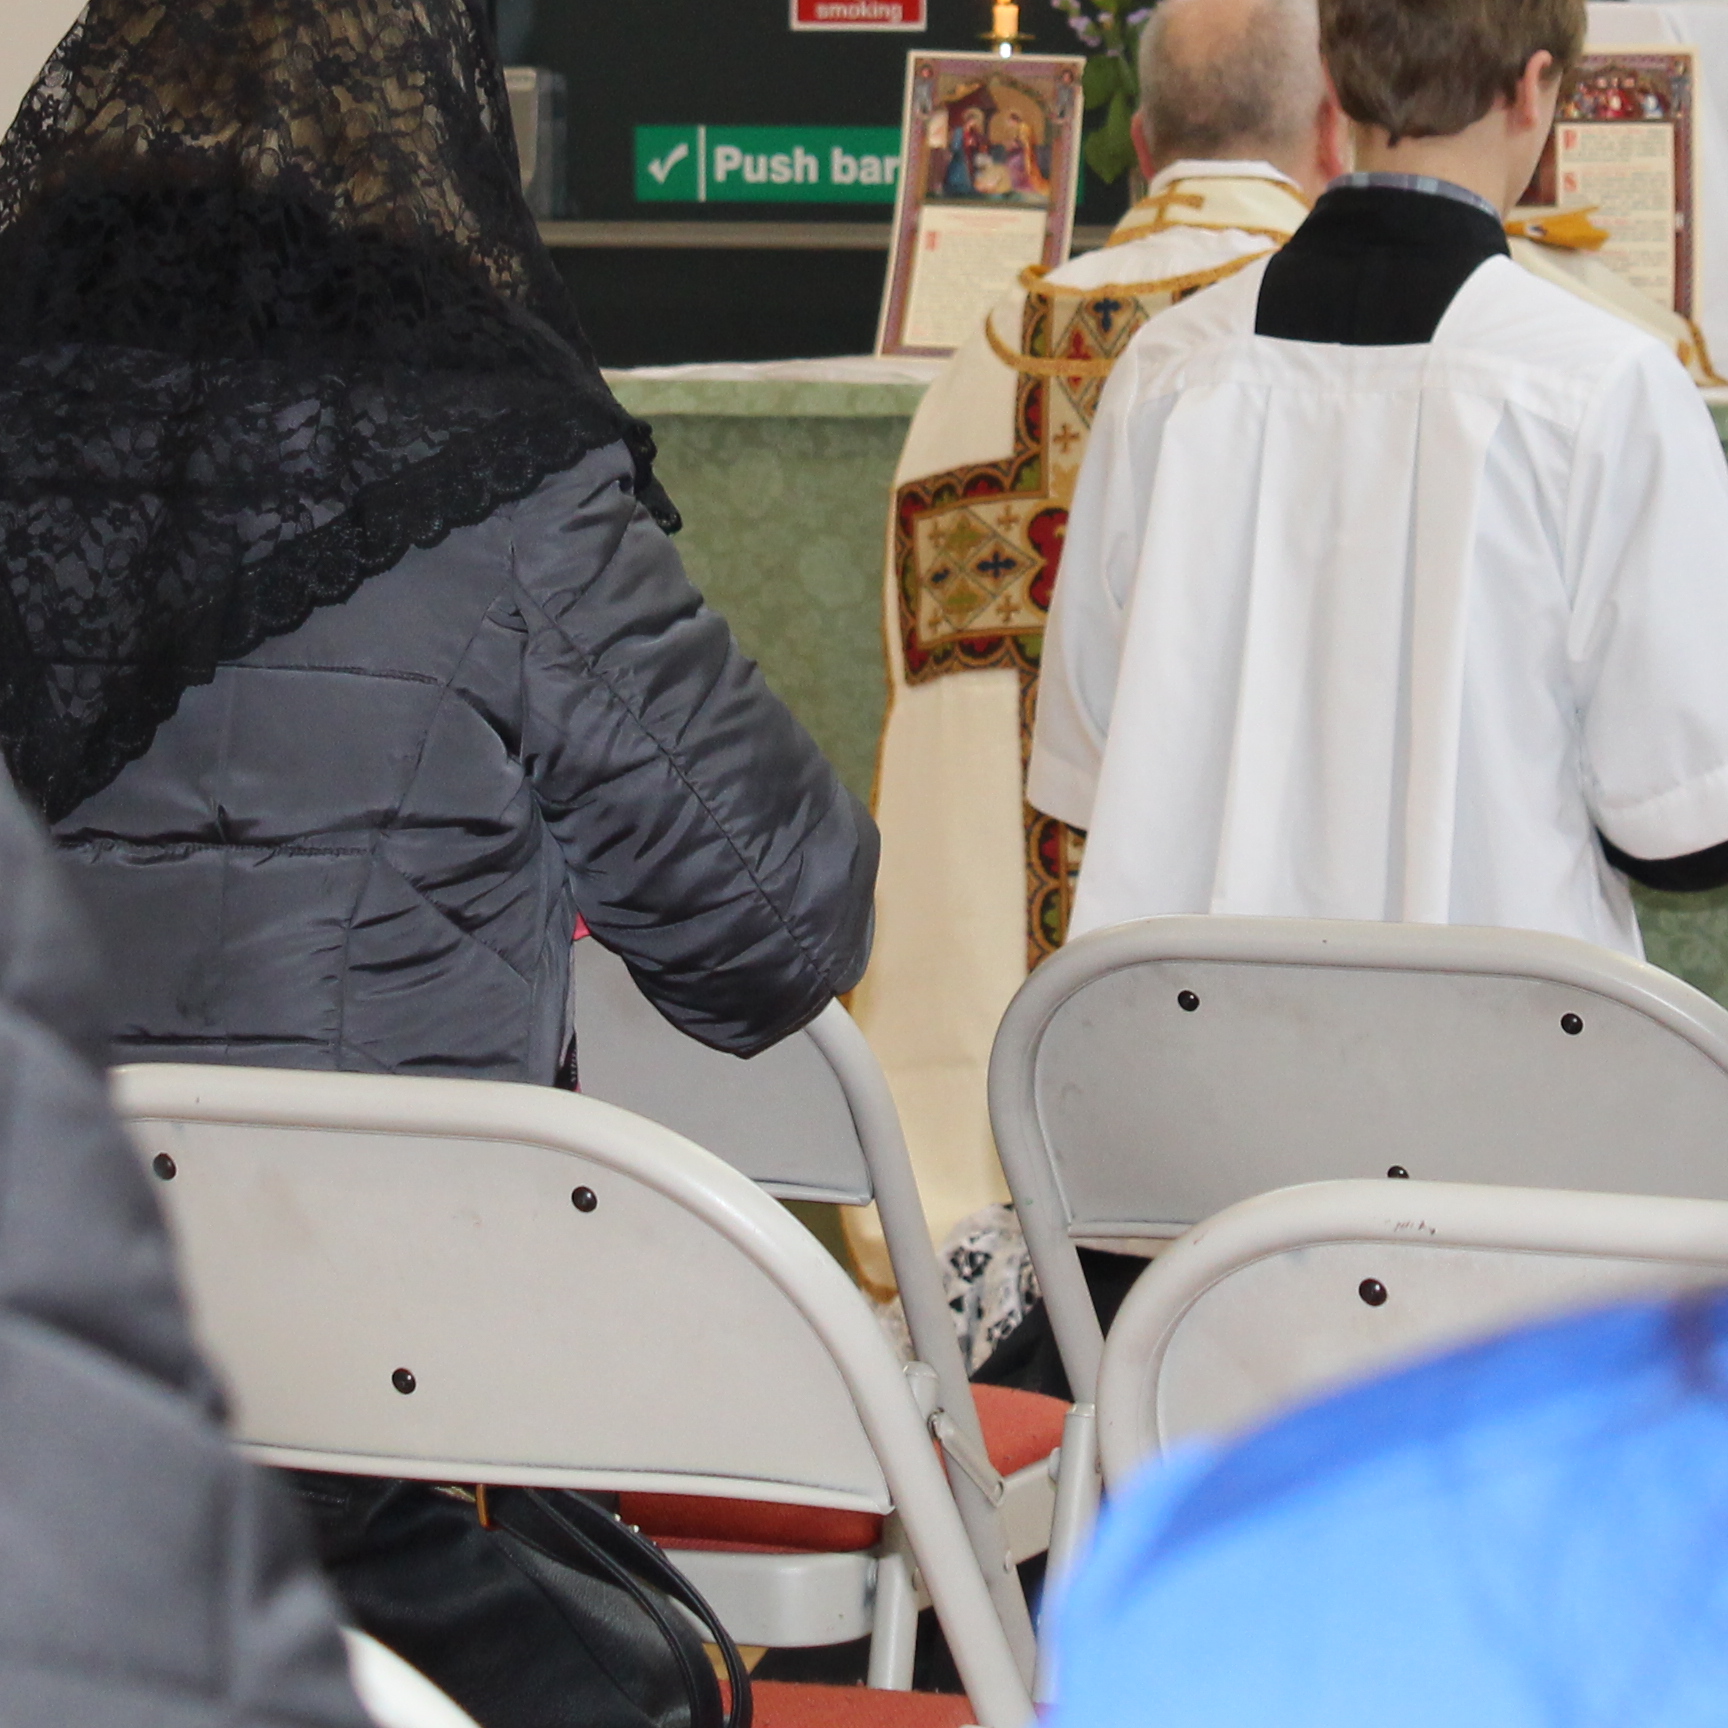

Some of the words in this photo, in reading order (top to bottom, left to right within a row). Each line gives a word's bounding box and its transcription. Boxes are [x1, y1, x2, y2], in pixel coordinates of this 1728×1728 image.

[815, 1, 903, 21] smoking
[714, 144, 819, 184] Push
[830, 145, 901, 184] bar
